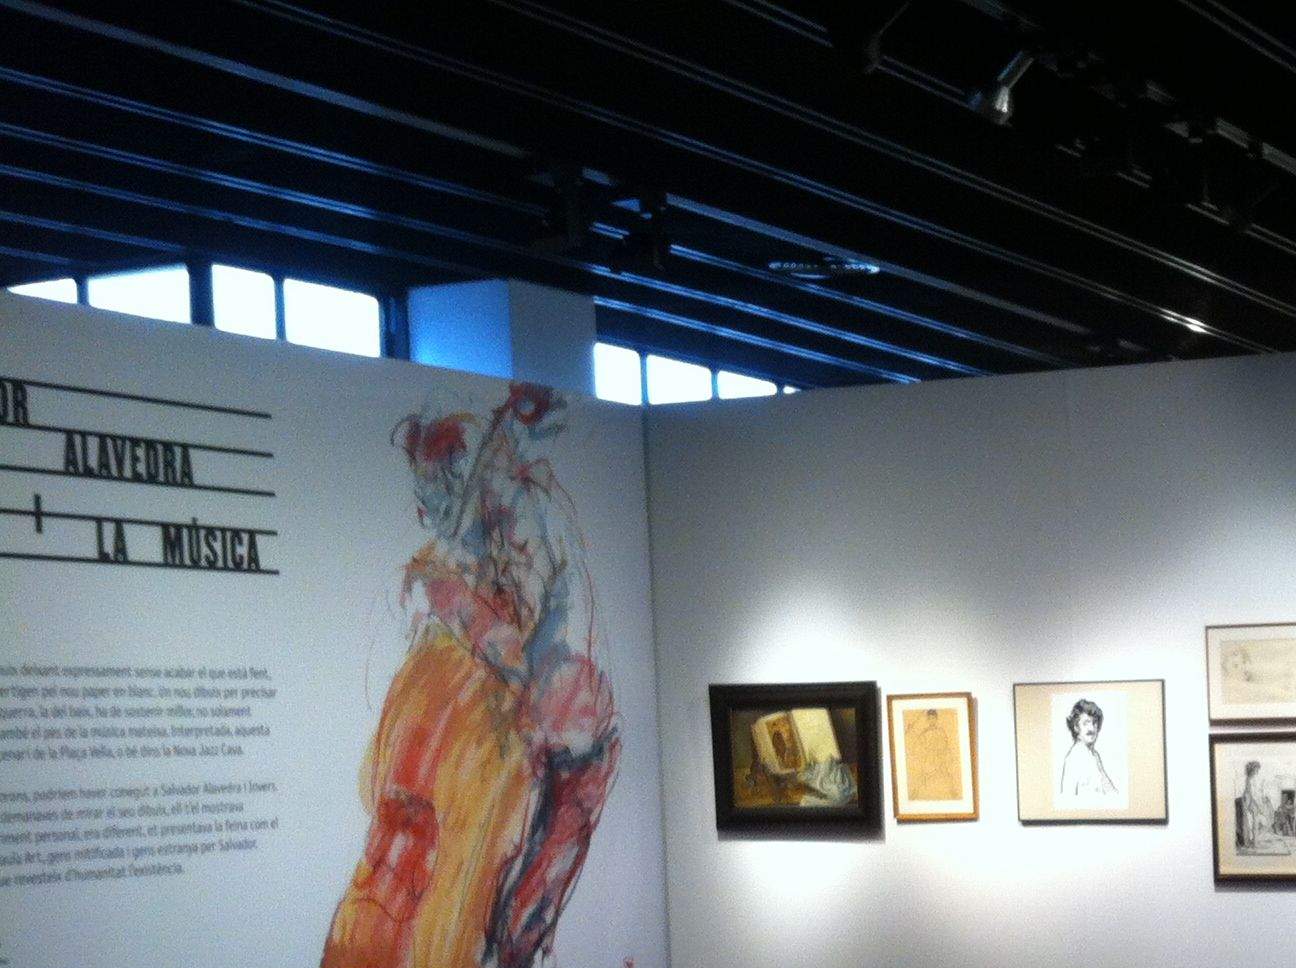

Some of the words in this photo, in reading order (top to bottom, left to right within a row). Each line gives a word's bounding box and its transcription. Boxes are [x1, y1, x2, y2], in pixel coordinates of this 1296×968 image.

[65, 431, 195, 487] ALAVEDRA
[96, 519, 129, 563] LA
[161, 517, 262, 572] MÚSICA
